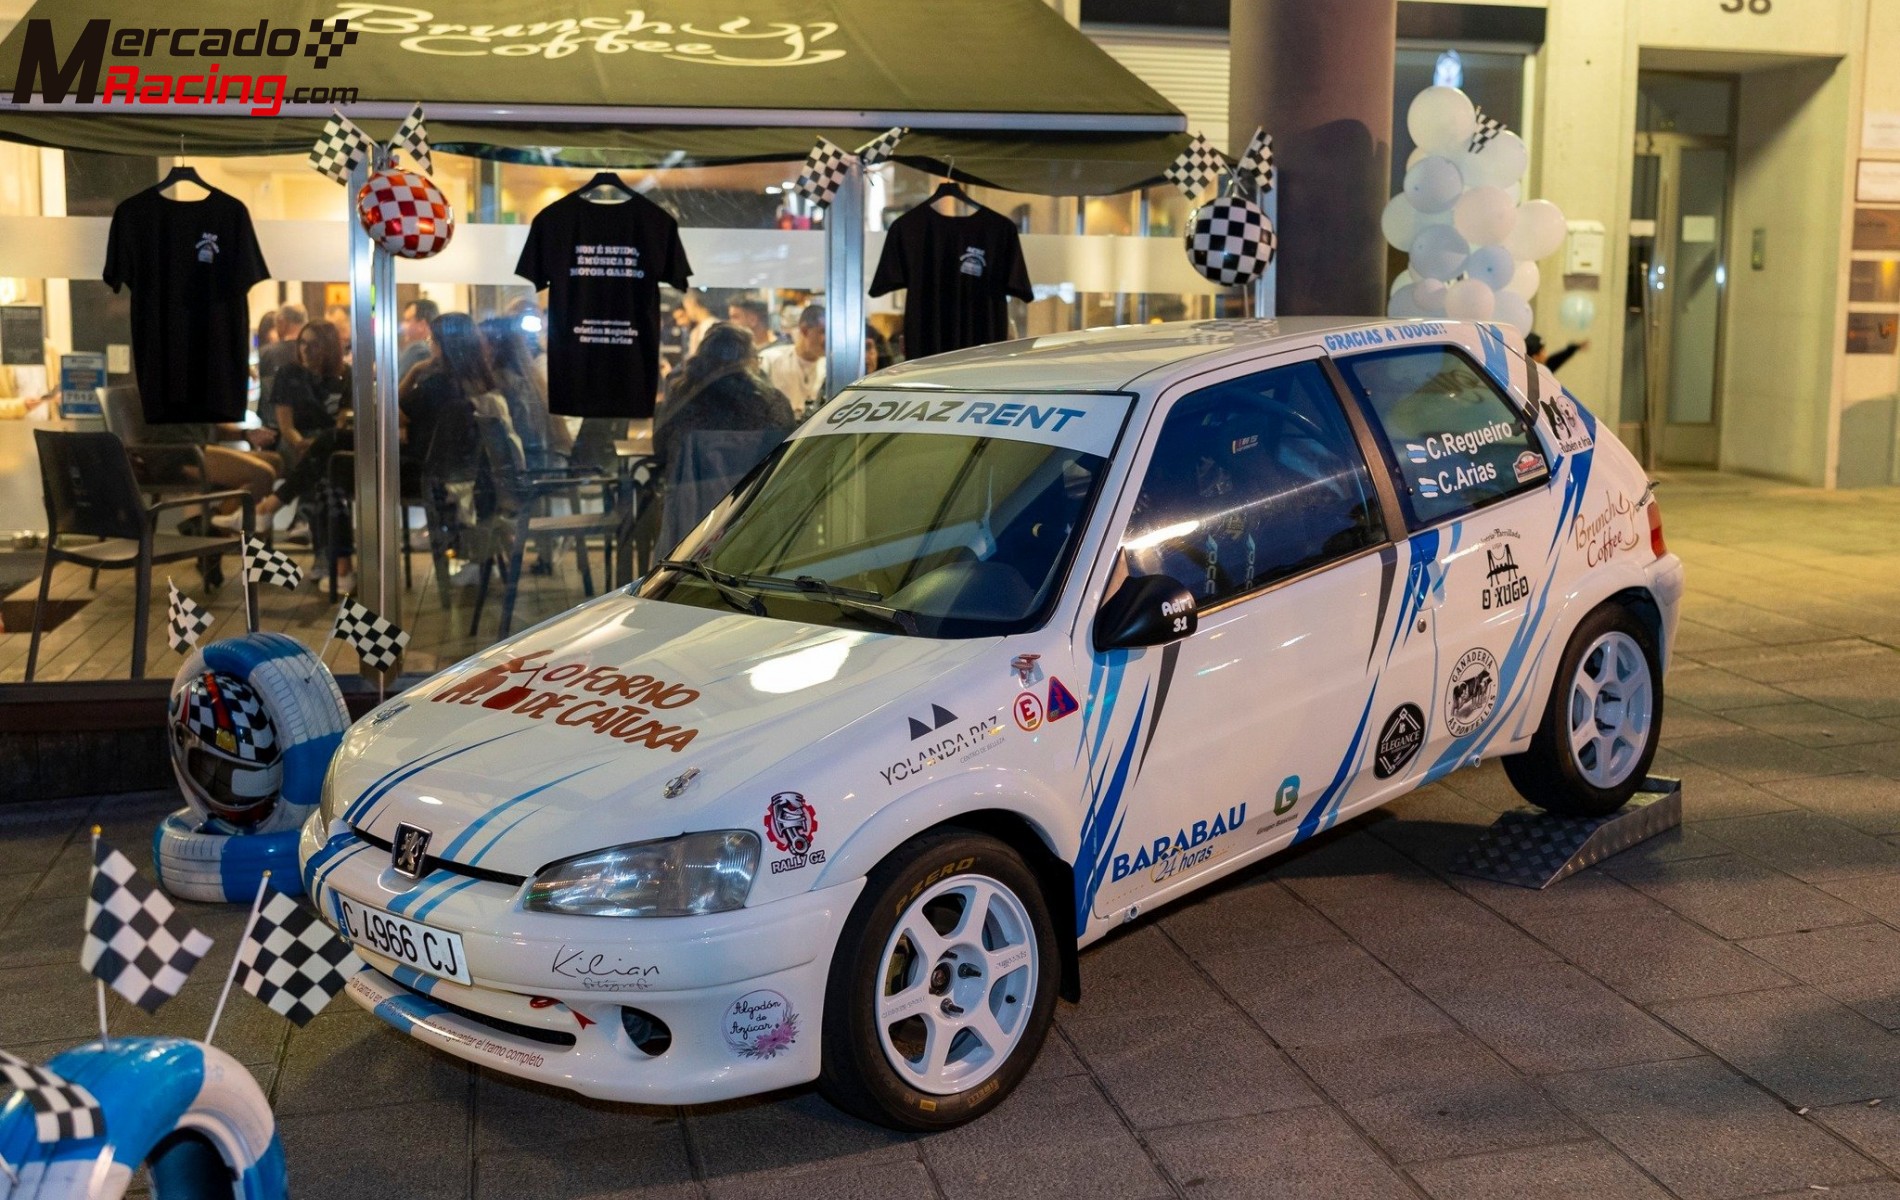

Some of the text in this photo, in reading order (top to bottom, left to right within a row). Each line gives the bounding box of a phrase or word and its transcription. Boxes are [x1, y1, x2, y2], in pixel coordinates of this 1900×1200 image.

[322, 2, 674, 36] Brunch
[399, 30, 717, 59] Coffee
[1324, 327, 1383, 351] GRACIAS
[1385, 327, 1397, 341] A
[865, 400, 965, 422] DIAZ
[956, 402, 1087, 432] RENT
[1426, 420, 1513, 460] C.Regueiro
[1438, 461, 1497, 494] C.Arias
[1587, 526, 1622, 568] Coffee
[1482, 575, 1529, 610] O XUGO
[542, 664, 701, 709] O FORNO
[512, 692, 699, 753] DE CATUXA
[1019, 698, 1036, 721] E
[880, 728, 970, 786] YOLANDA
[1381, 729, 1421, 753] ELEGANCE
[1112, 802, 1247, 884] BARABAU
[1178, 844, 1214, 871] horas
[771, 849, 827, 875] RALLY GZ
[342, 901, 458, 976] C 4966 CJ
[552, 944, 660, 978] Kilian
[732, 1000, 782, 1020] Algodón
[755, 1014, 767, 1022] de
[730, 1021, 772, 1041] Azúcar
[506, 1048, 544, 1068] completo
